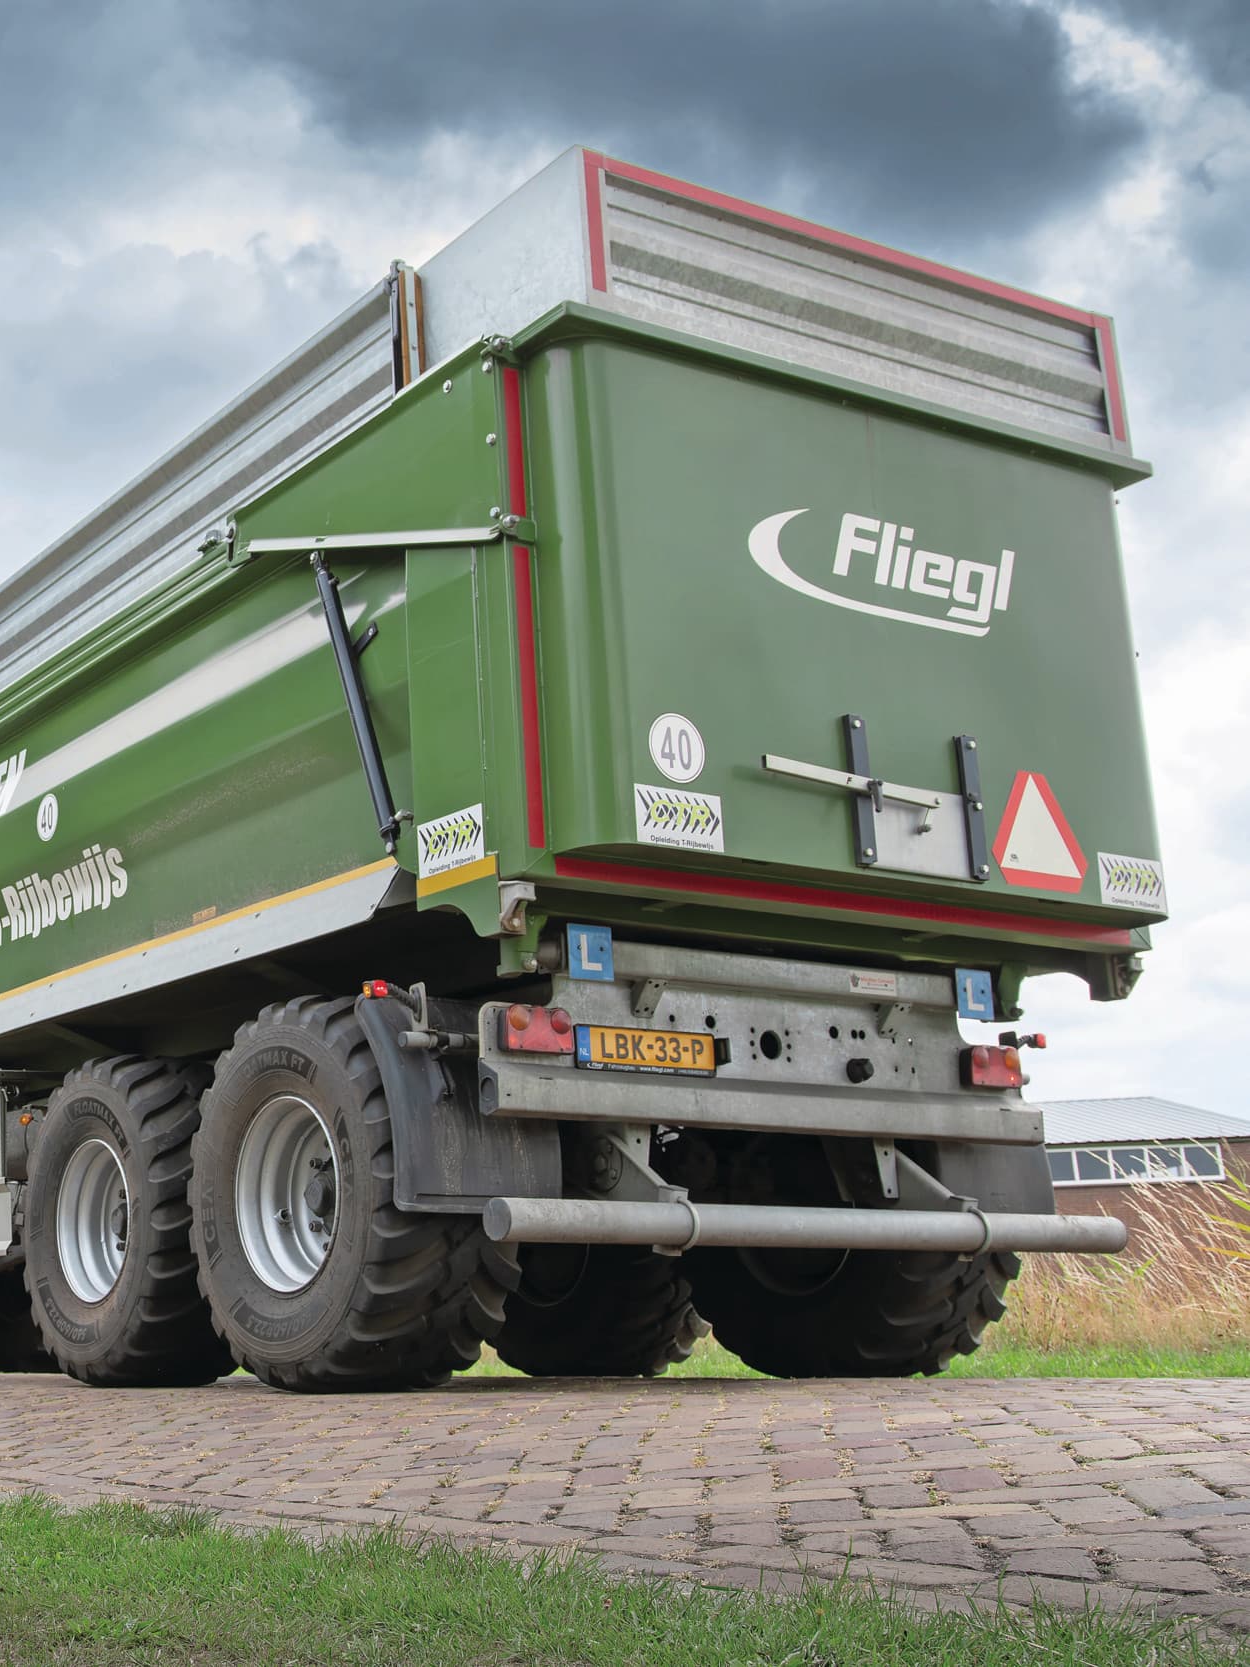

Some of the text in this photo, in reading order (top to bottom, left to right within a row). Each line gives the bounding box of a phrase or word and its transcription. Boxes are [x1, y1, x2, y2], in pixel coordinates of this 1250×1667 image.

[833, 512, 1015, 623] Fliegl
[660, 726, 692, 770] 40
[40, 802, 54, 833] 40
[649, 799, 711, 829] CTR
[430, 819, 474, 855] CTR
[650, 834, 680, 847] Opleiding
[1110, 865, 1156, 892] CTR
[580, 934, 602, 971] L
[966, 977, 985, 1011] L
[290, 1053, 305, 1072] FT
[579, 1032, 704, 1065] NL LBK-33-P
